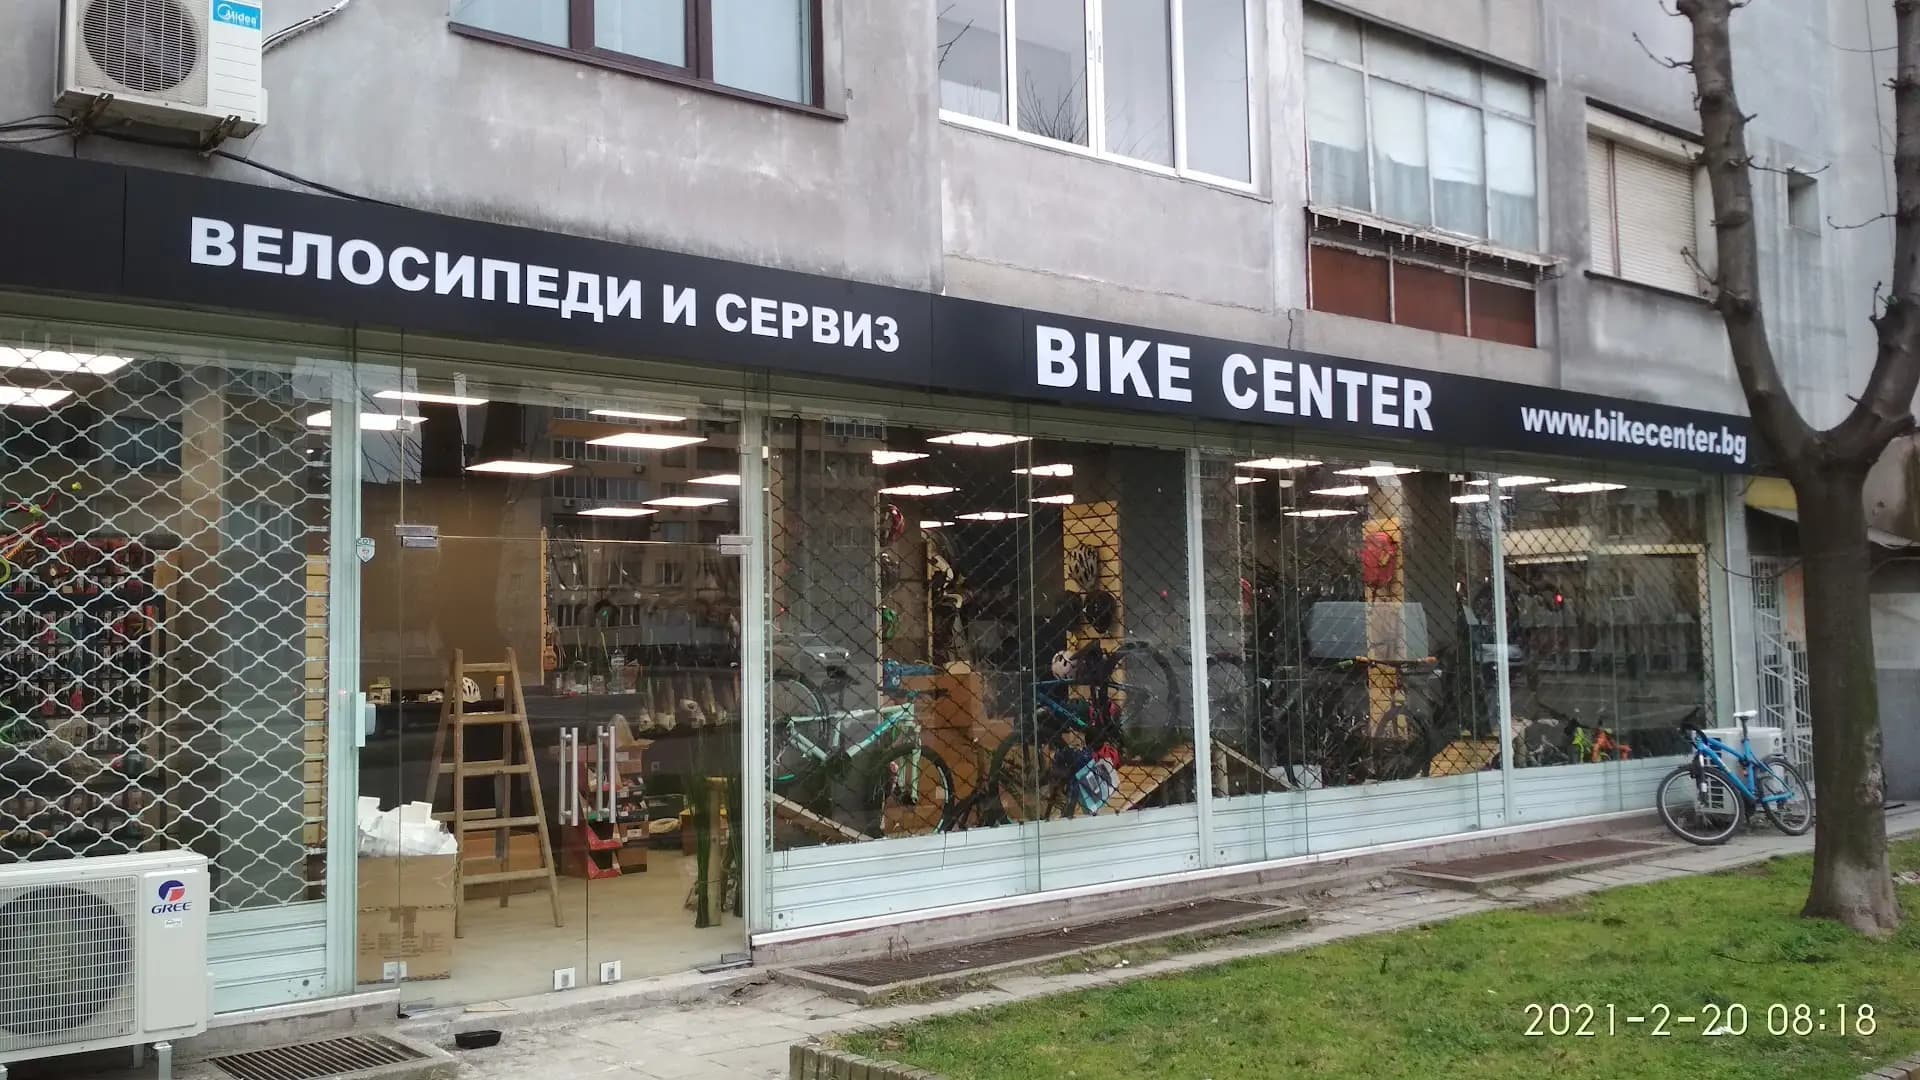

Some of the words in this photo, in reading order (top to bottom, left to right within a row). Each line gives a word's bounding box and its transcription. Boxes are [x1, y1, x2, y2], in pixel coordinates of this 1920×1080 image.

[190, 216, 642, 324] ВЕЛОСИПЕДИ
[662, 284, 697, 327] И
[715, 292, 900, 353] СЕРВИЗ
[1036, 324, 1193, 403] BIKE
[1221, 353, 1434, 431] CENTER
[1520, 405, 1747, 464] www.bikecenter.bg
[151, 901, 192, 914] GREE
